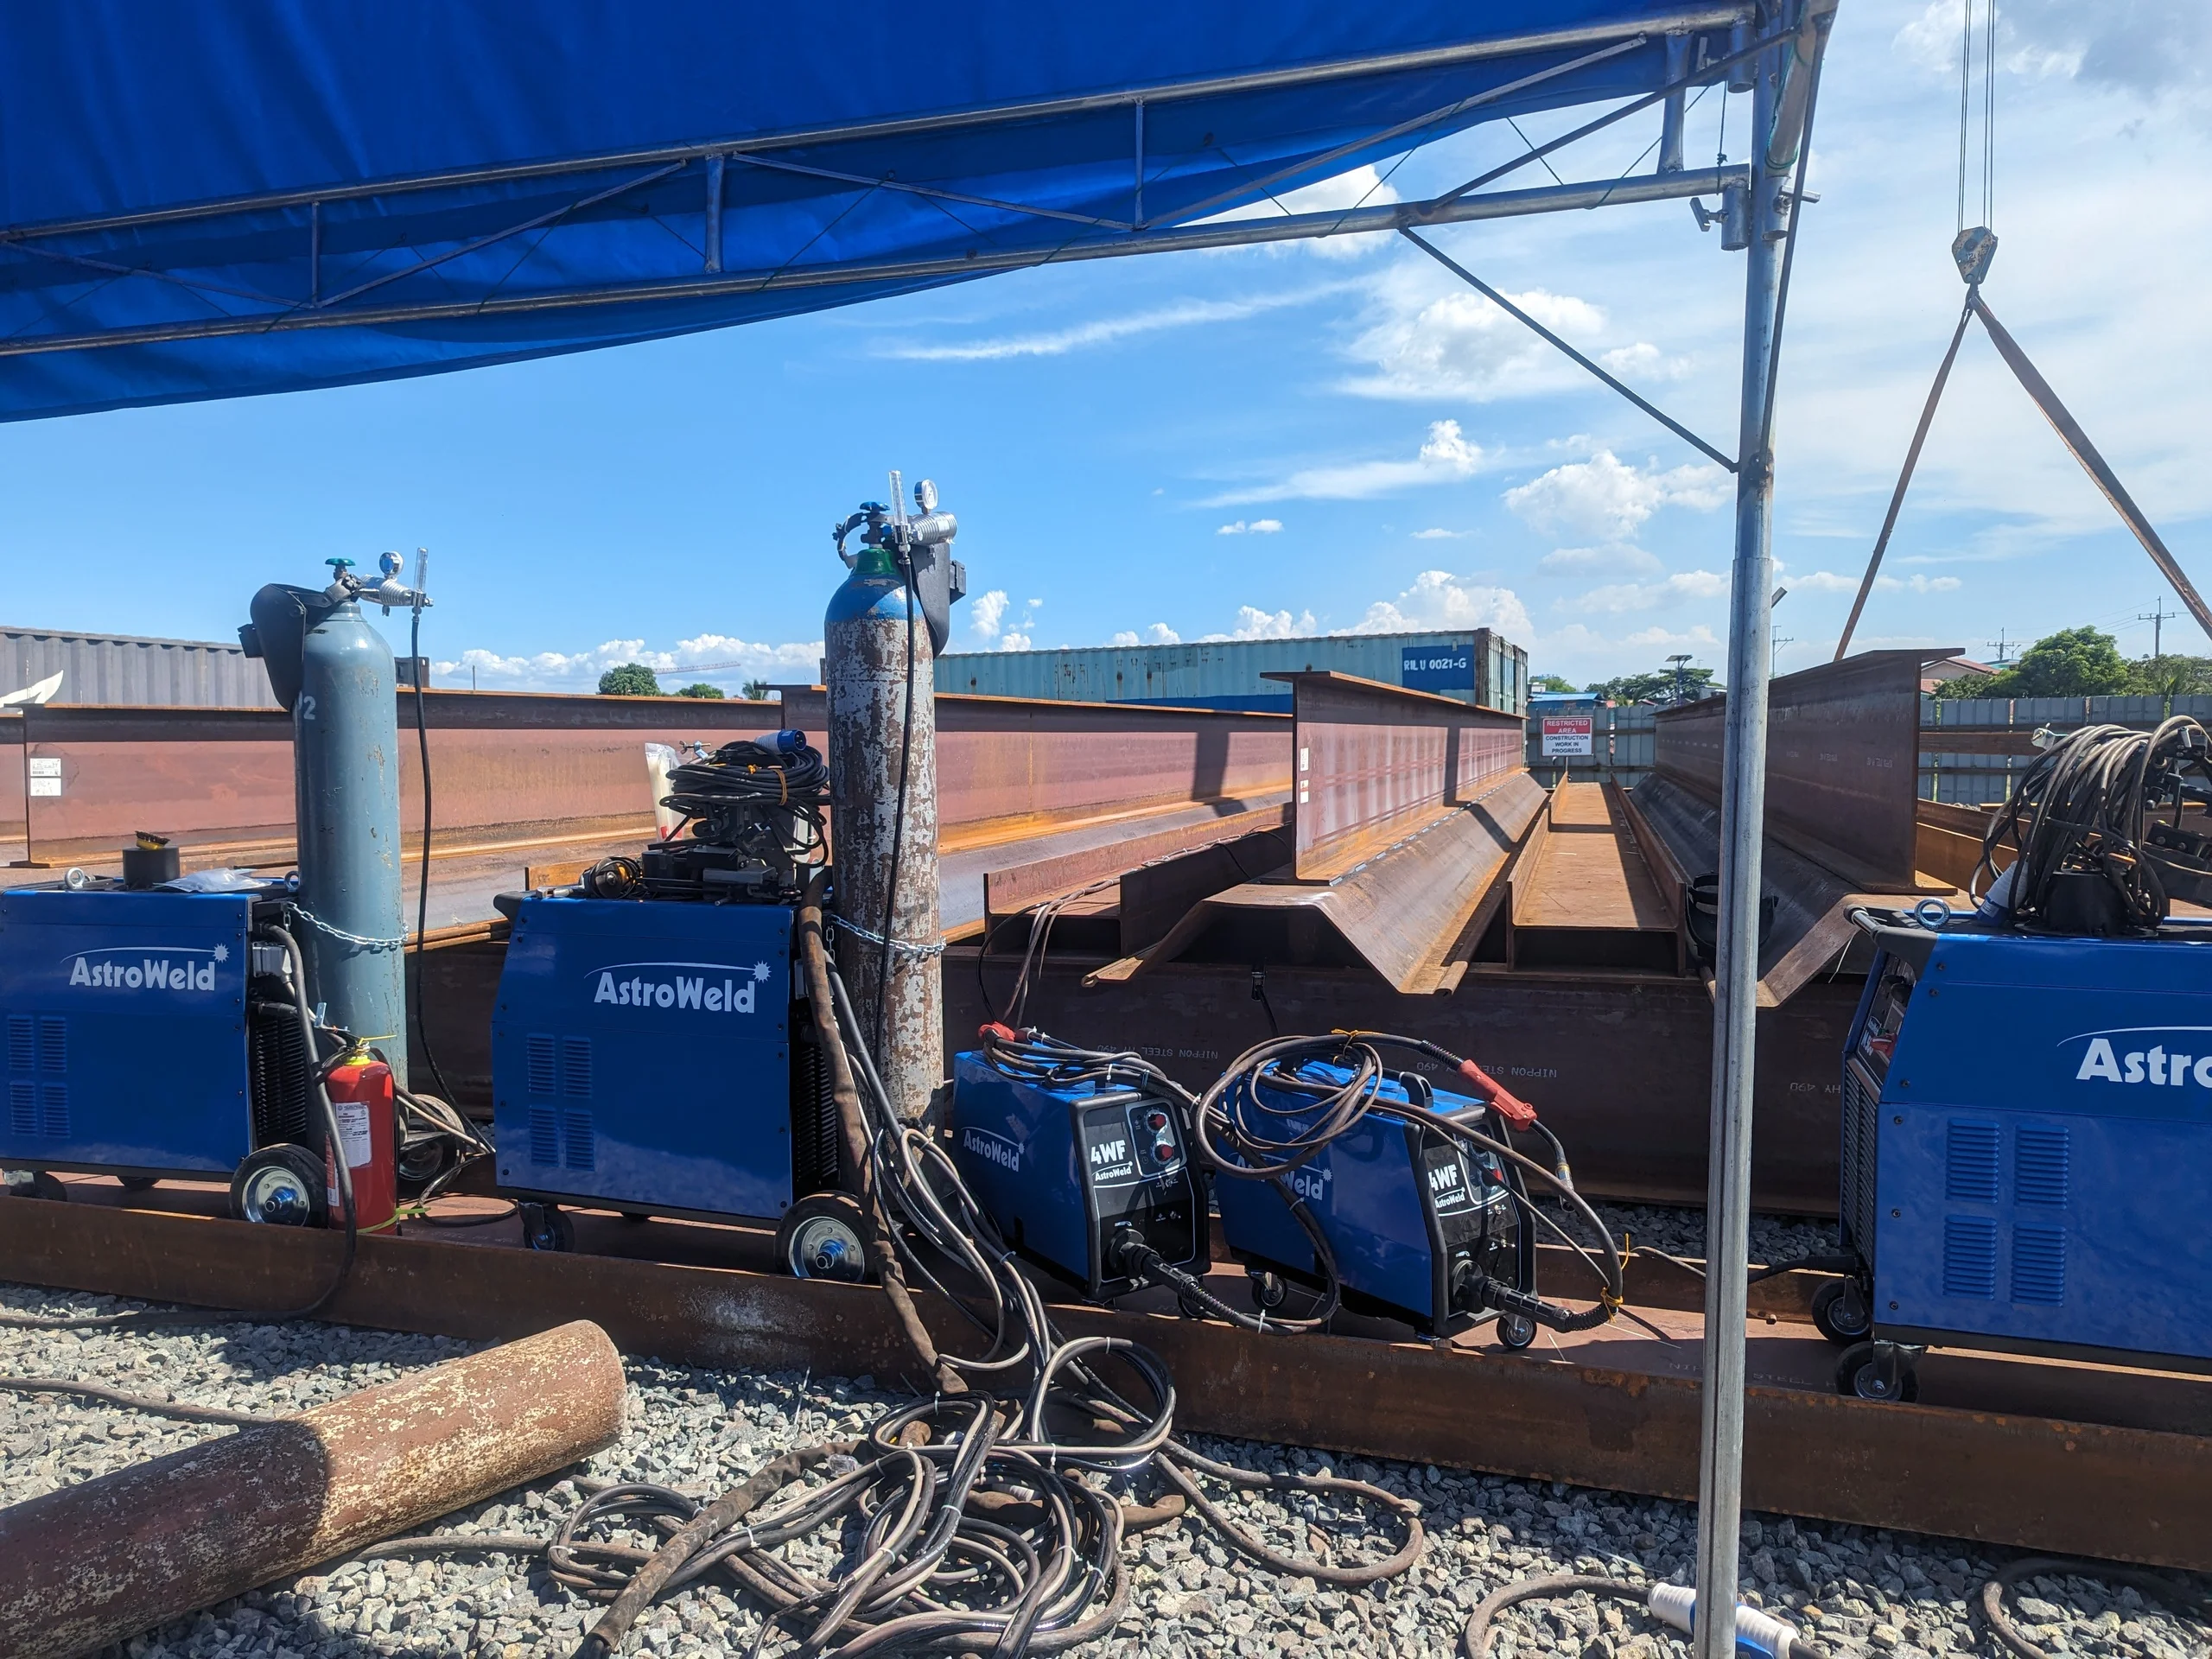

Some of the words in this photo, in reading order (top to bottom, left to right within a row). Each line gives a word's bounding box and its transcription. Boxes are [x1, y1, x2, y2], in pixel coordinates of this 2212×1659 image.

[1429, 658, 1466, 670] 0021-G
[69, 957, 215, 991] AstroWeld
[594, 971, 755, 1014] AstroWeld
[1141, 1046, 1173, 1058] STEEL
[1179, 1048, 1218, 1059] NIPPON
[1416, 1061, 1438, 1071] 490
[1511, 1066, 1557, 1078] NIPPON
[1789, 1082, 1815, 1092] 490
[963, 1129, 1020, 1173] AstroWeld
[1090, 1140, 1126, 1165] 4WF
[1095, 1166, 1132, 1181] AstroWeld
[1428, 1164, 1458, 1191] 4WF
